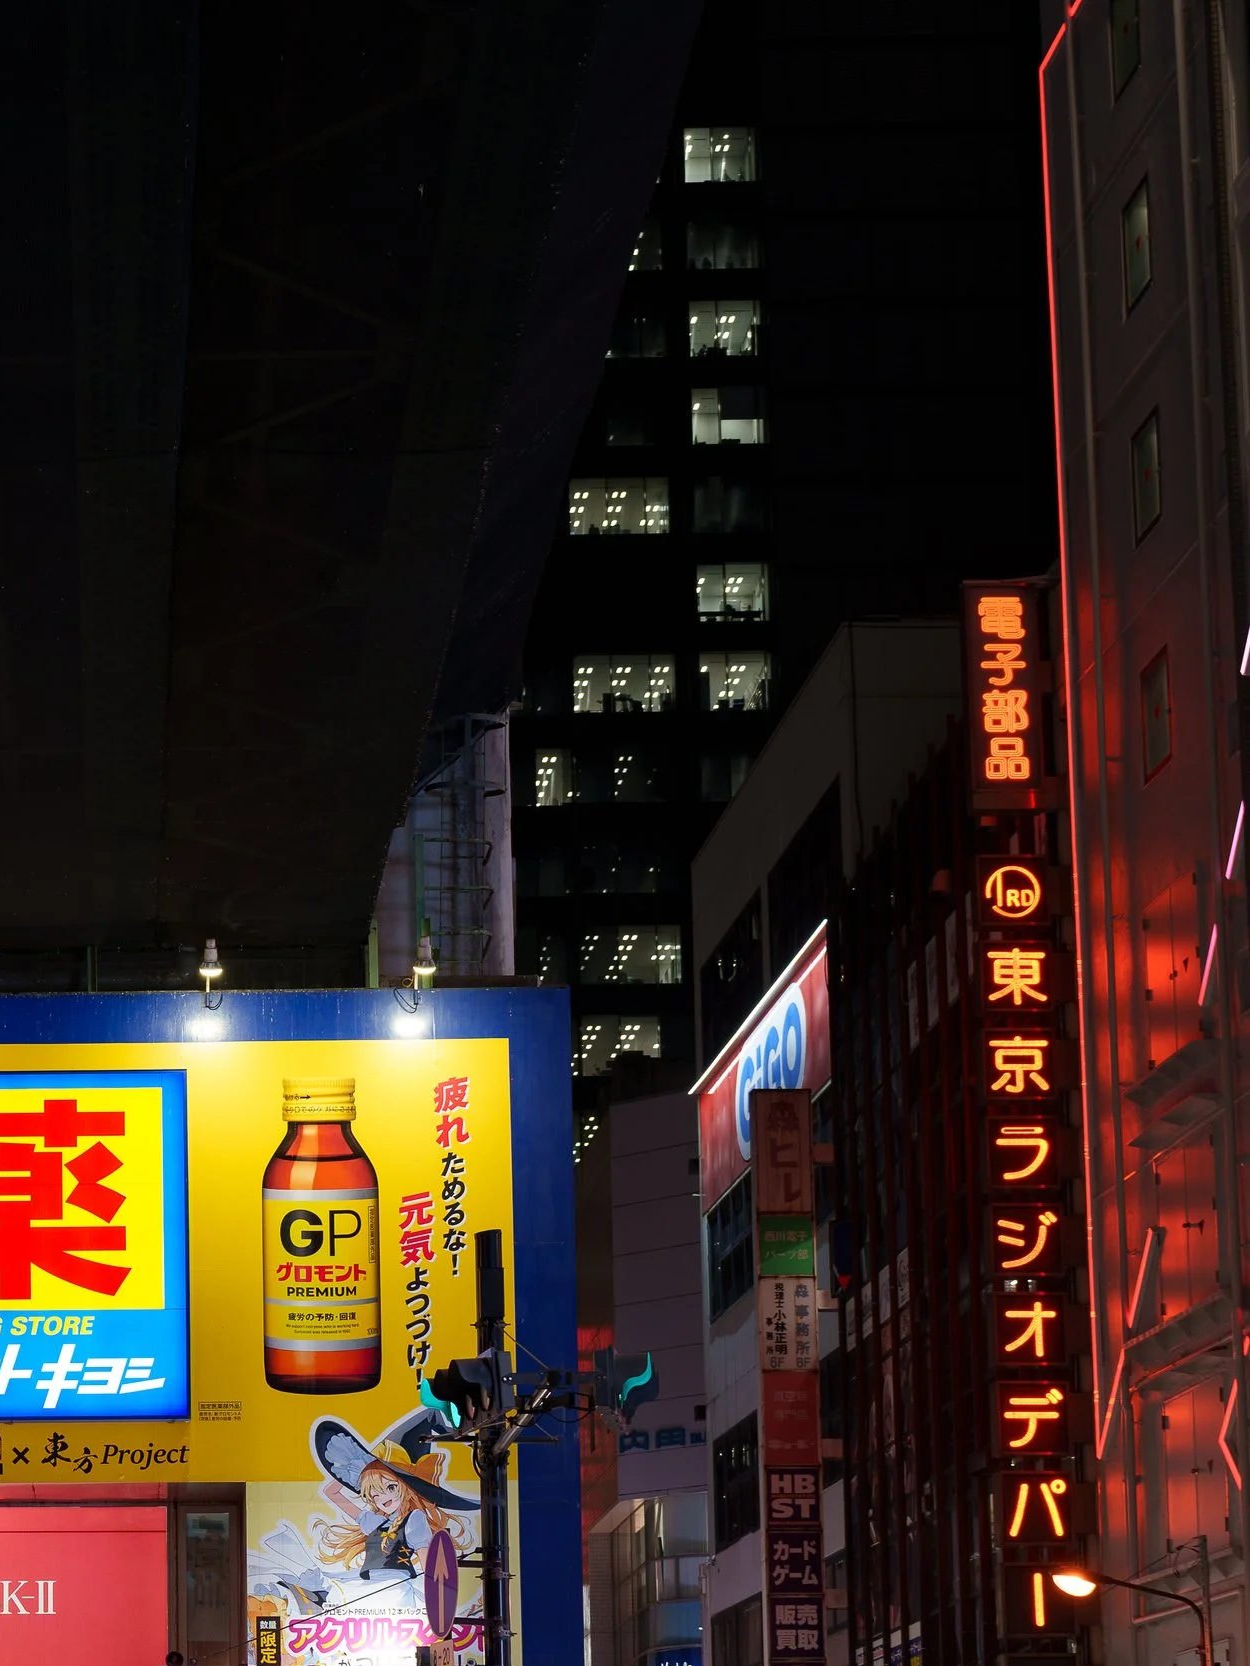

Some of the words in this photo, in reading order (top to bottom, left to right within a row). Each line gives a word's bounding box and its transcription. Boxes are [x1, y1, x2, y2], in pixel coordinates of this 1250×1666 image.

[978, 596, 1030, 780] 電子部品
[280, 1209, 362, 1257] GP
[287, 1286, 356, 1296] PREMIUM
[10, 1316, 95, 1335] STORE
[771, 1474, 815, 1494] HB
[771, 1499, 816, 1519] ST
[773, 1541, 816, 1561] カード
[773, 1566, 818, 1587] ゲーム
[775, 1604, 818, 1625] 販売
[260, 1631, 277, 1664] 限定
[776, 1630, 819, 1650] 買取
